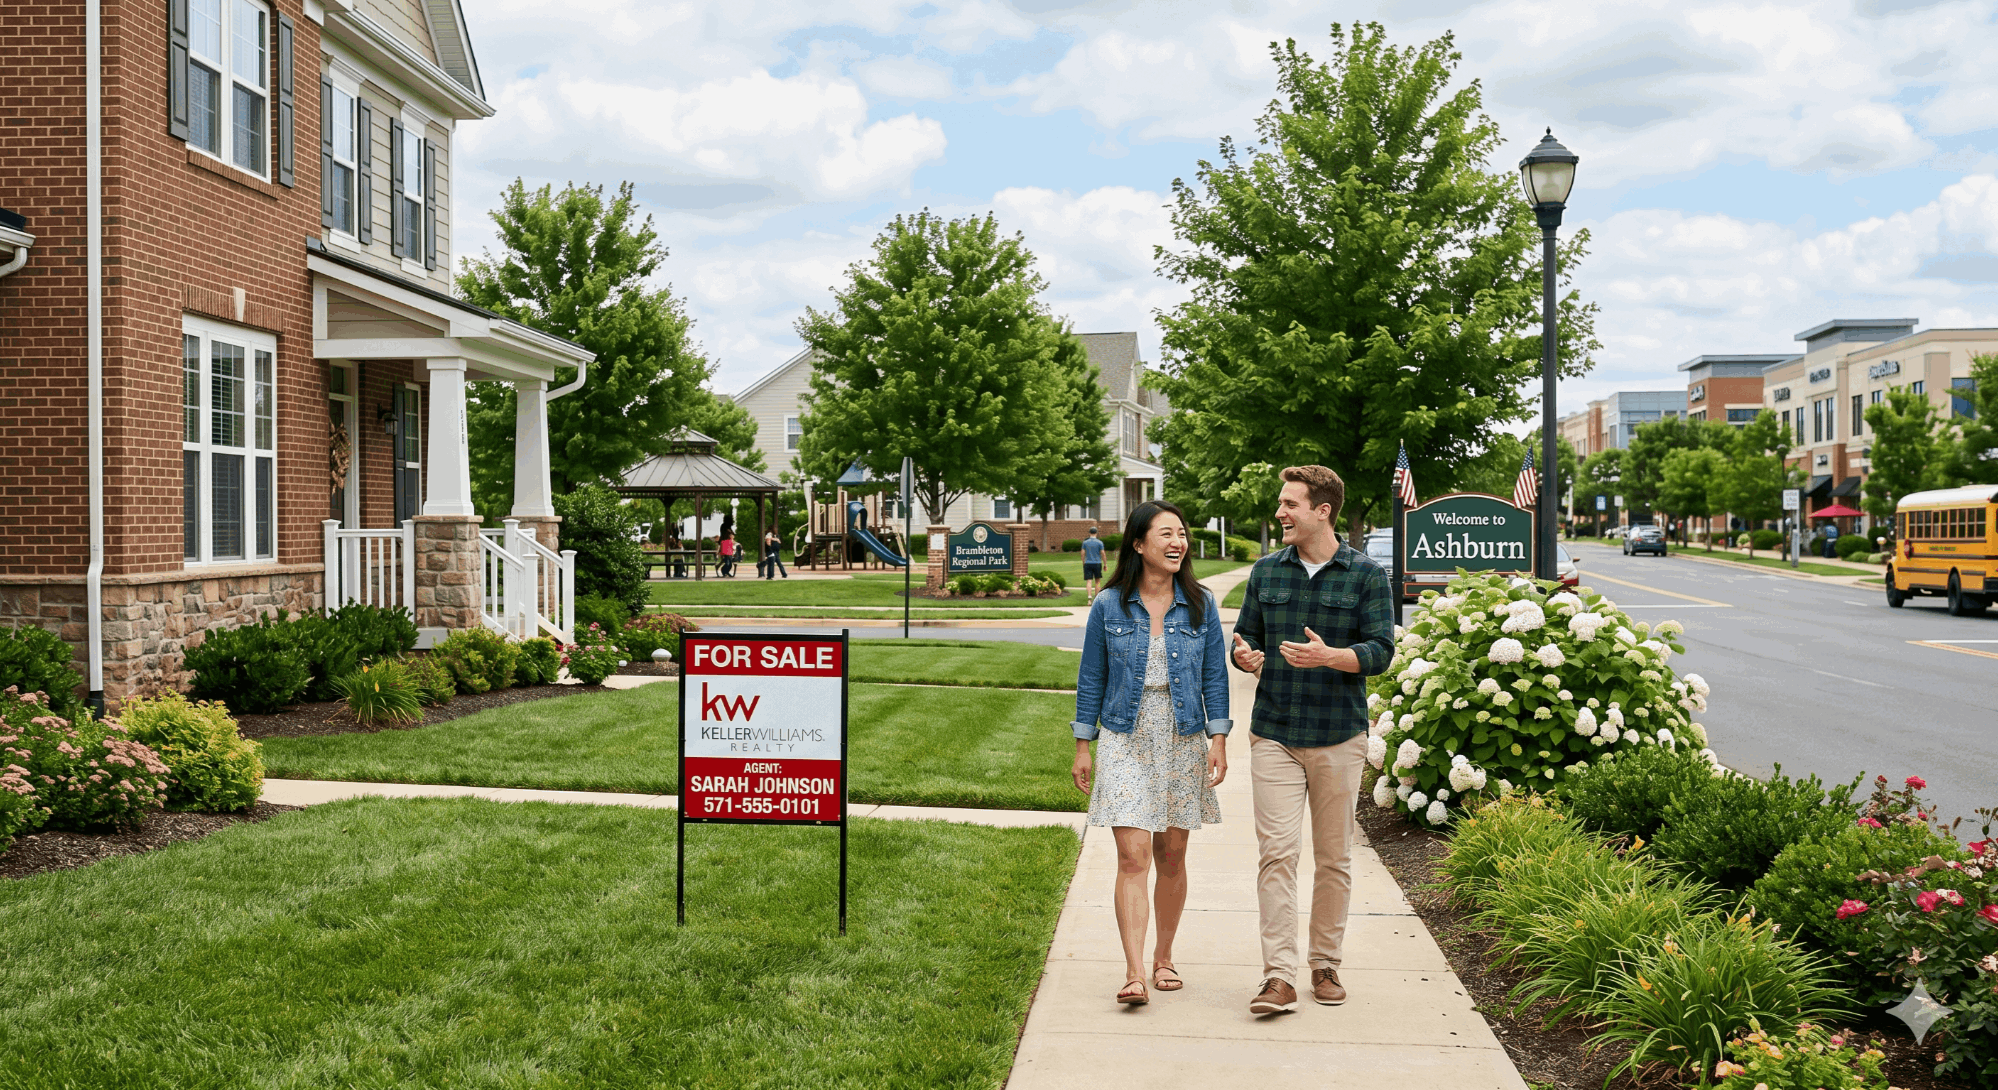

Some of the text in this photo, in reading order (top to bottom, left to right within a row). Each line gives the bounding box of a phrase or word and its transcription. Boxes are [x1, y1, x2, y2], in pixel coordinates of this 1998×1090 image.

[1432, 512, 1506, 526] Welcome to
[956, 545, 1003, 555] Brambleton
[1411, 532, 1526, 560] Ashburn
[952, 556, 1007, 568] Regional Park
[694, 644, 834, 669] FOR SALE
[701, 682, 760, 721] kw
[730, 743, 795, 752] REALTY
[743, 763, 782, 774] AGENT:
[690, 775, 835, 794] SARAH JOHNSON
[703, 797, 819, 815] 571-555-0101
